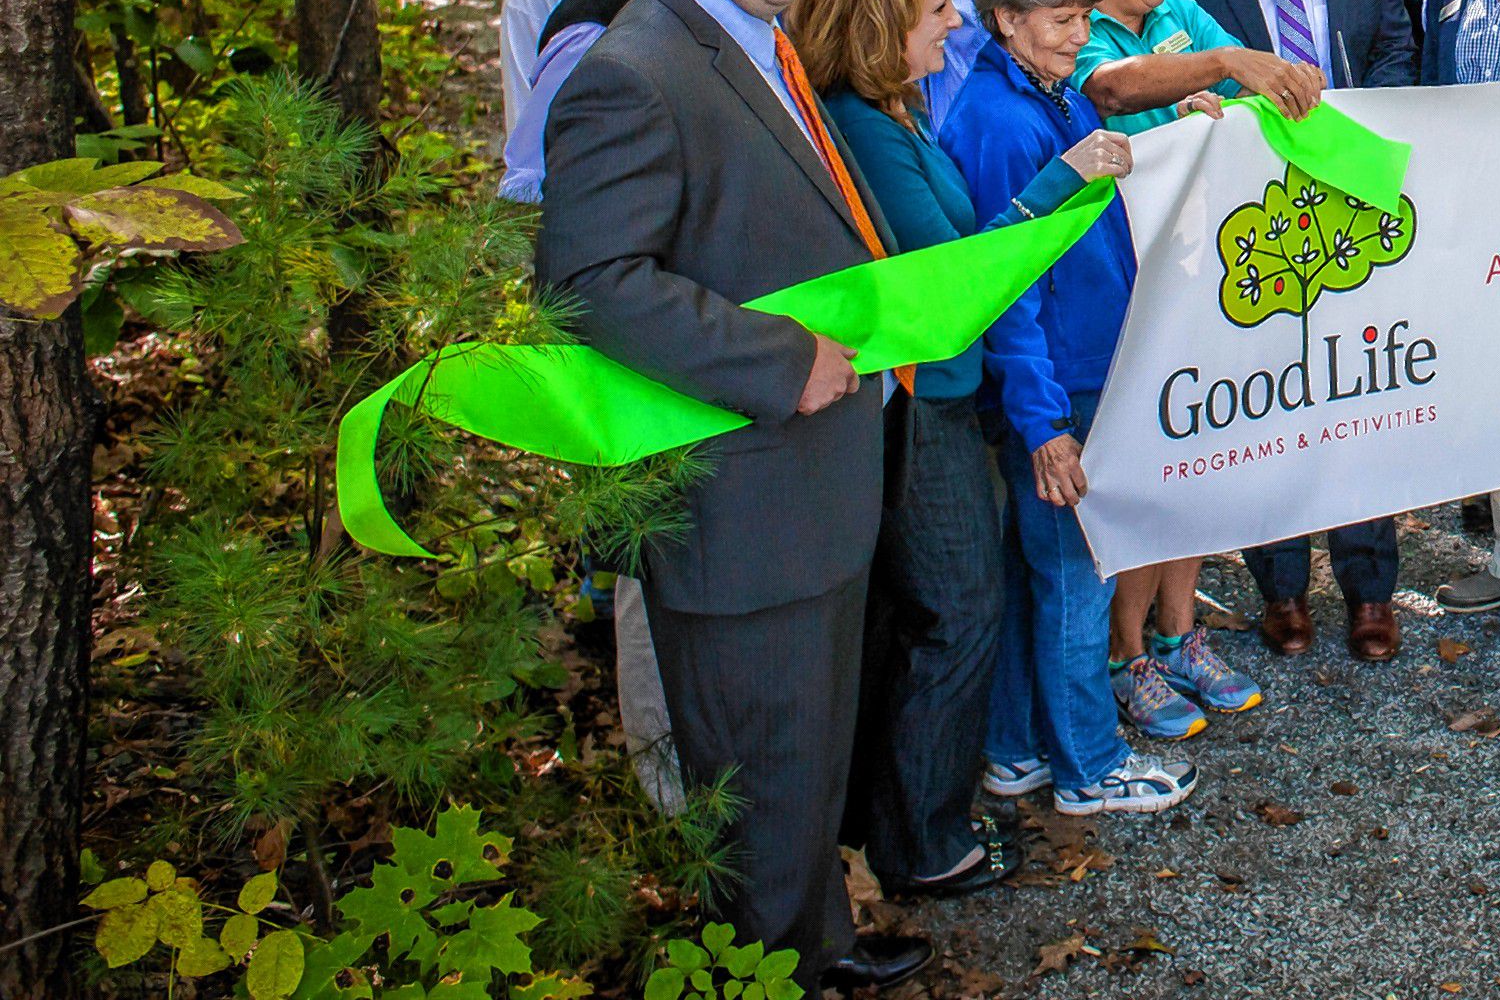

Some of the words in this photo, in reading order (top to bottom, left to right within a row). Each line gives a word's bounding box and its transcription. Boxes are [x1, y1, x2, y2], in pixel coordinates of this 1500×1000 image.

[1158, 350, 1315, 440] Good
[1322, 319, 1438, 402] Life
[1162, 437, 1287, 482] PROGRAMS
[1297, 433, 1310, 450] &
[1319, 405, 1438, 444] ACTIVITIES
